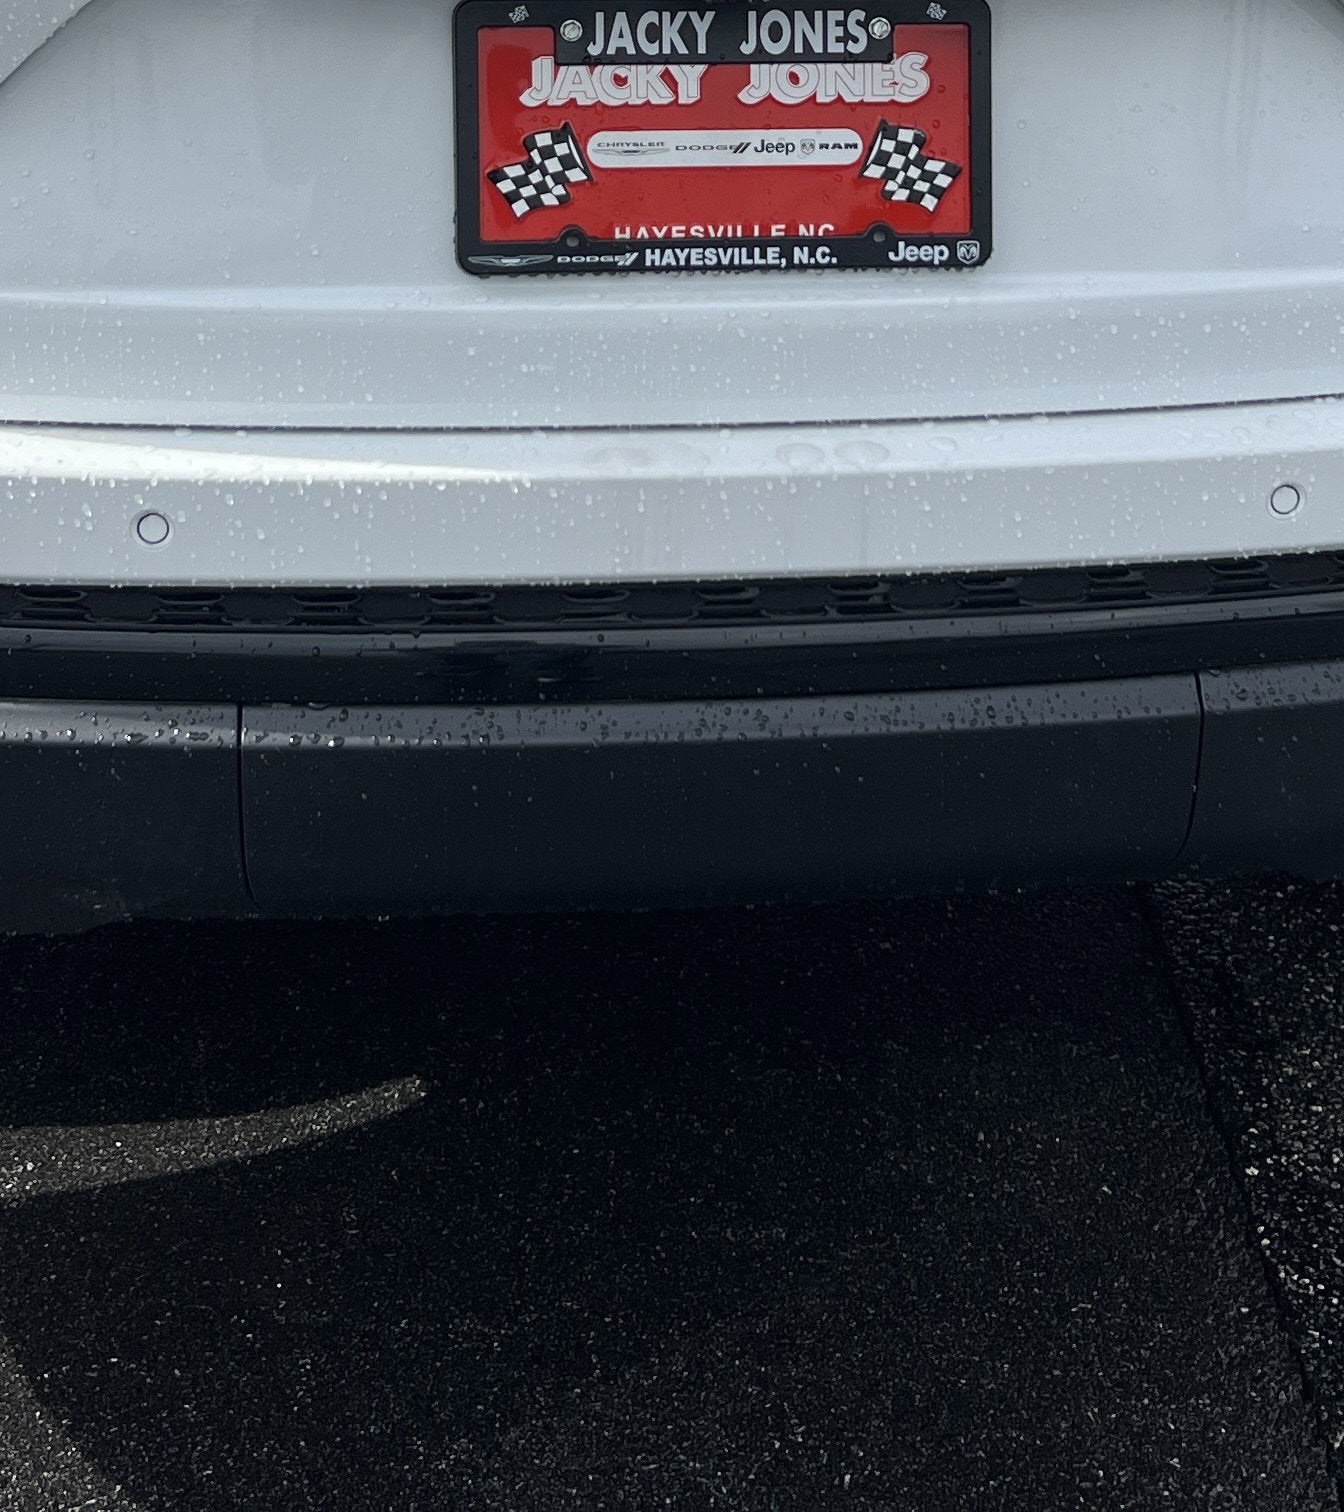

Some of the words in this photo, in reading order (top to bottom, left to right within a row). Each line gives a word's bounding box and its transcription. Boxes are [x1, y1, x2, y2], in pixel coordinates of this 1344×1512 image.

[587, 10, 716, 56] JACKY
[739, 9, 869, 55] JONES
[519, 55, 709, 107] JACKY
[737, 52, 930, 105] JONES
[596, 140, 666, 148] CHRYSLER
[753, 138, 796, 156] Jeep
[818, 142, 859, 150] RAM
[644, 246, 788, 268] HAYESVILLE,
[793, 246, 839, 265] N.C.
[887, 240, 950, 265] Jeep
